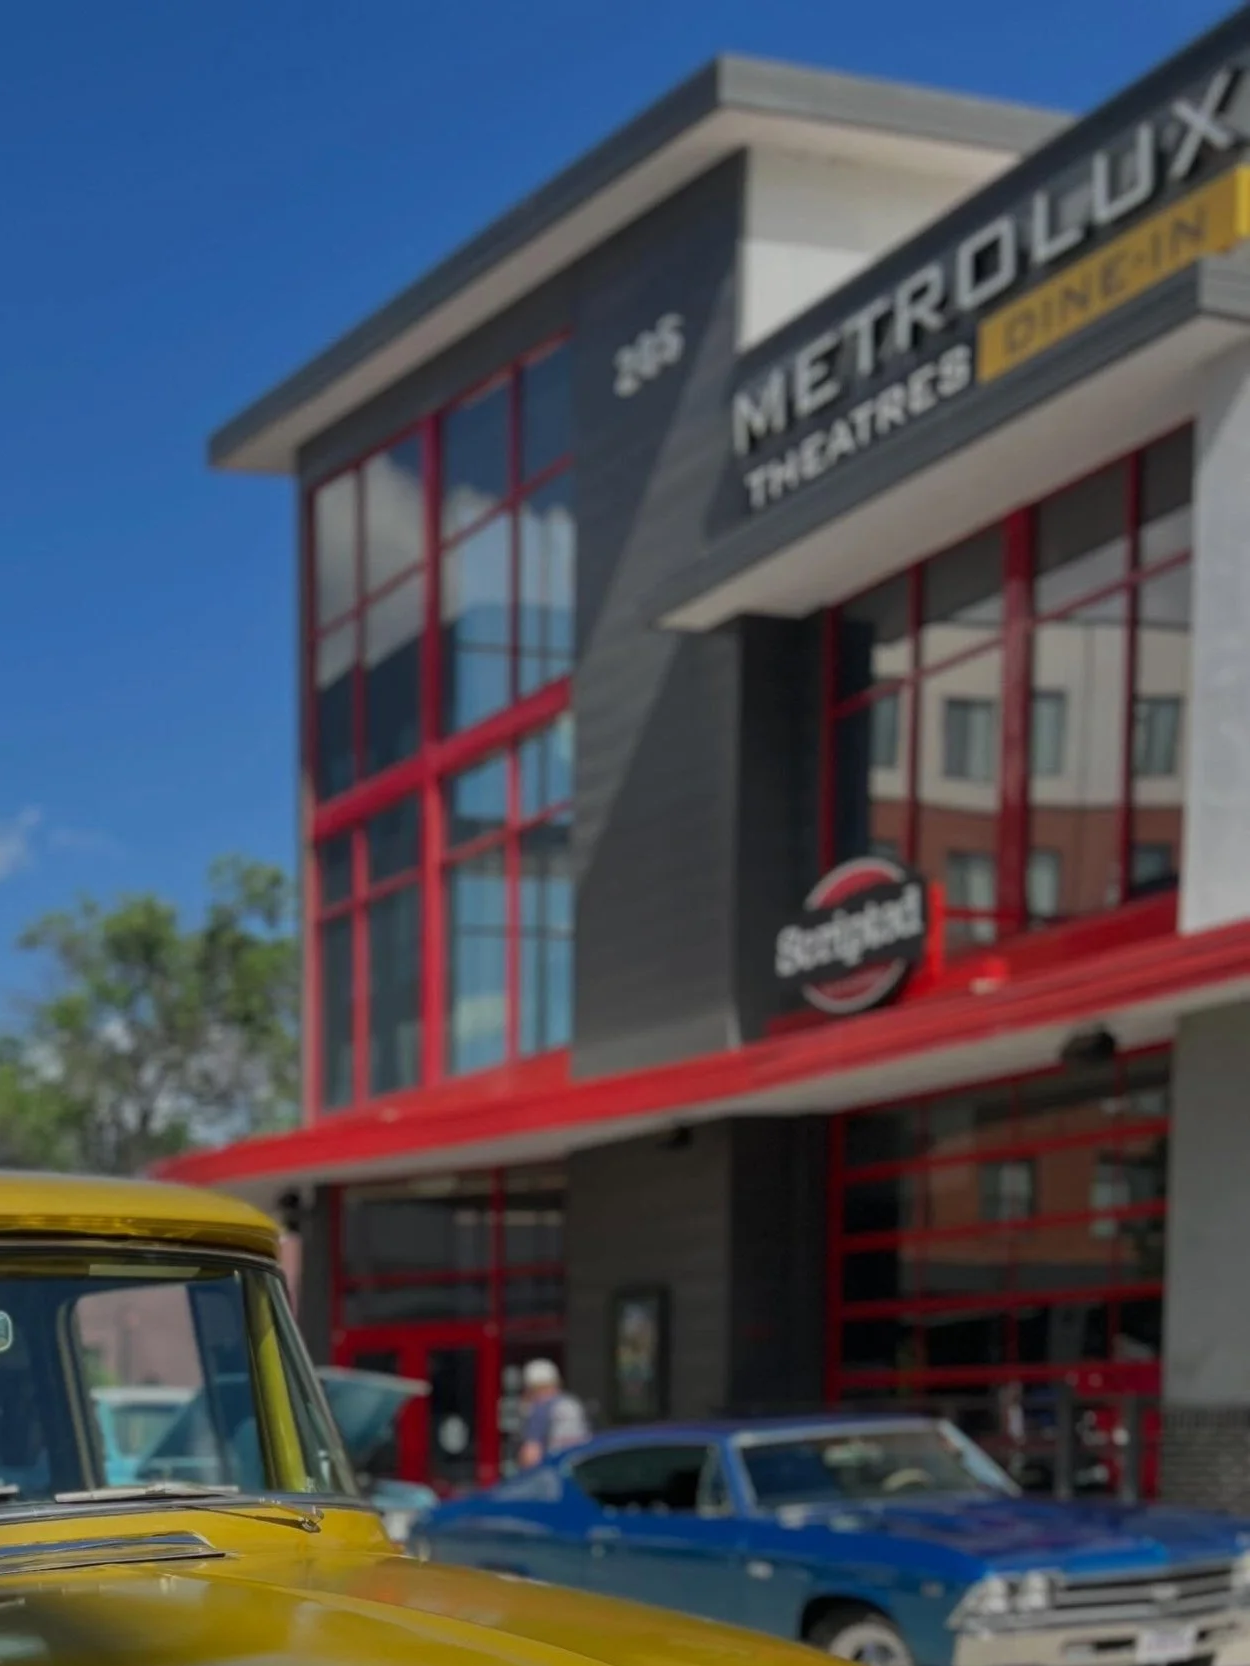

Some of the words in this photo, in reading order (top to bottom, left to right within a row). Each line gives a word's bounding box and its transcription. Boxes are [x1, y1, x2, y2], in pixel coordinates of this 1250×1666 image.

[732, 67, 1239, 457] METROLUX
[1003, 202, 1210, 356] DINE-IN
[746, 343, 972, 508] THEATRES
